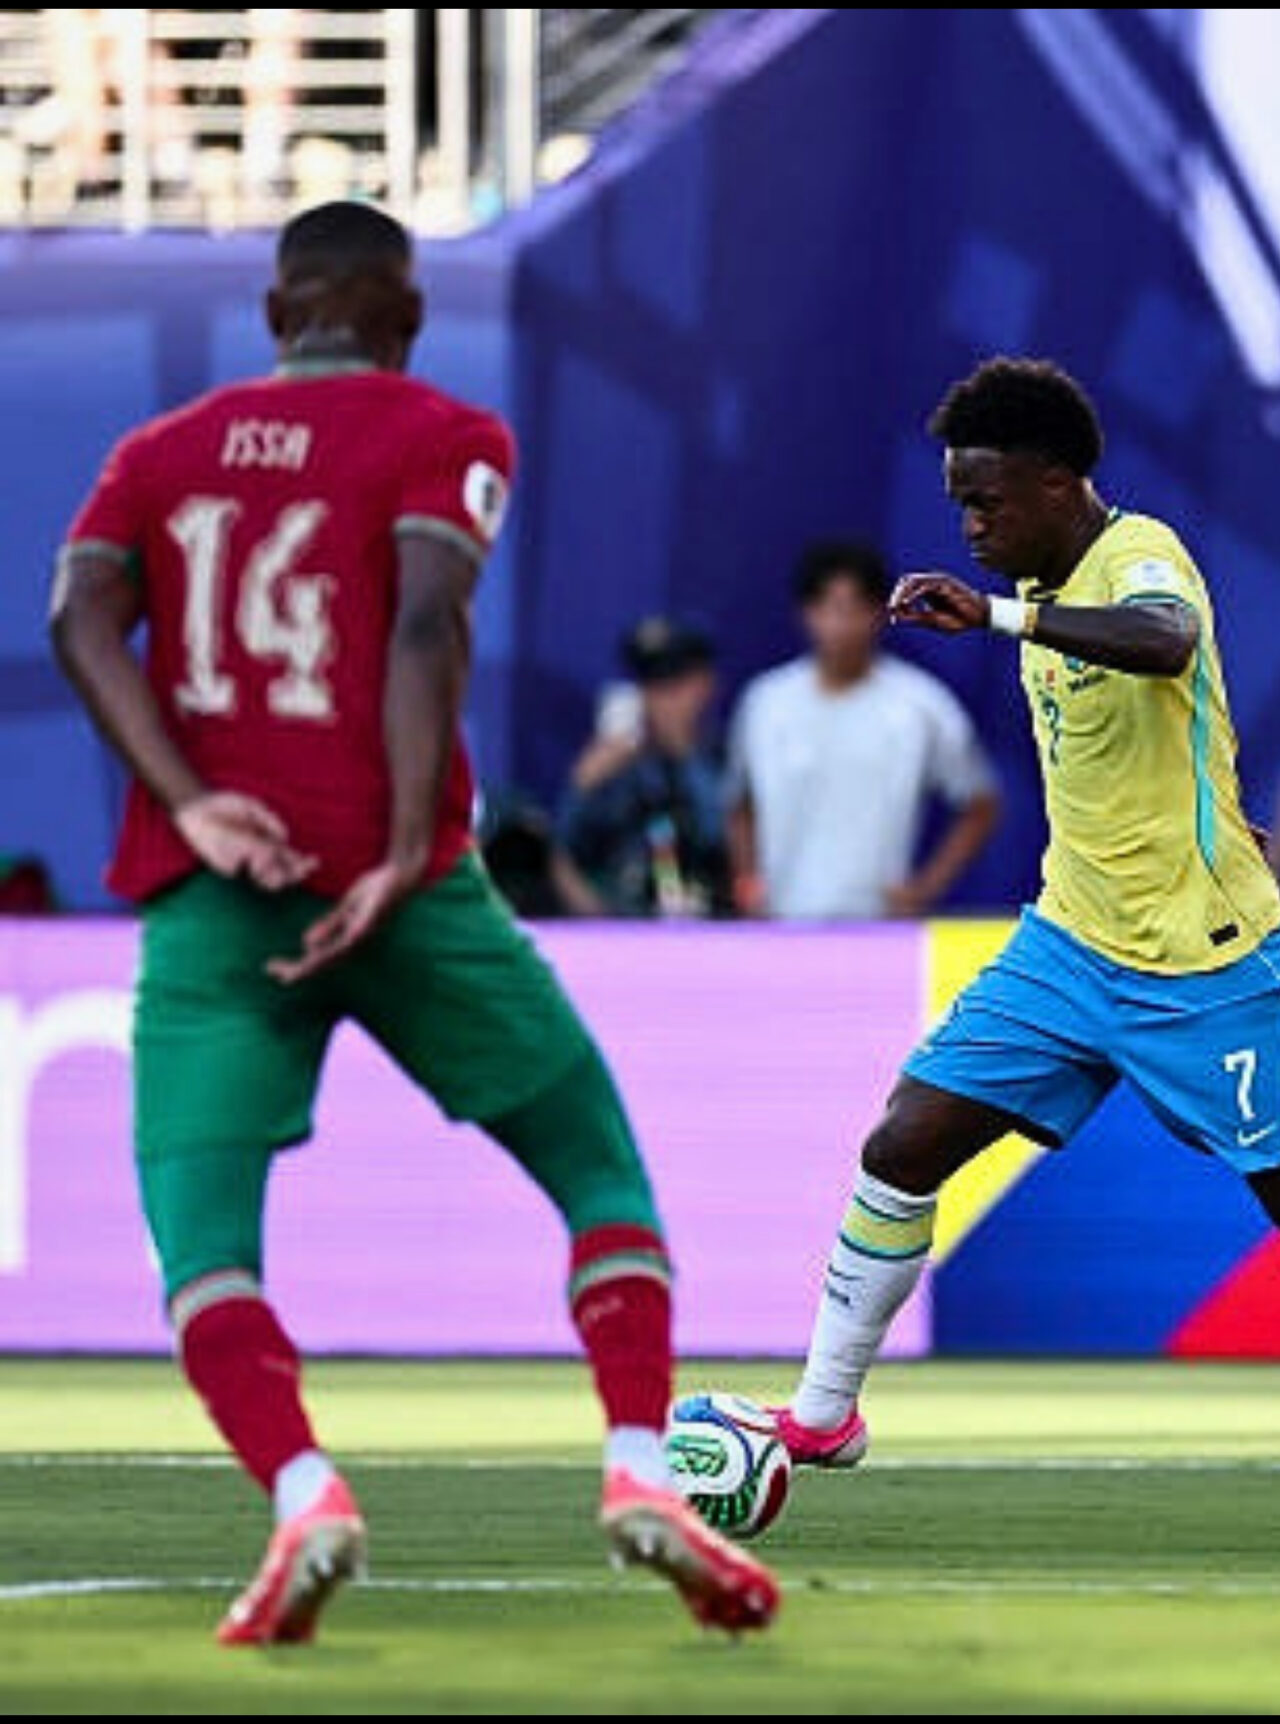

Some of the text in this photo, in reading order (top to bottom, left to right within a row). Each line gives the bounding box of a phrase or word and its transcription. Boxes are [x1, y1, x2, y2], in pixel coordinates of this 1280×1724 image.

[220, 418, 312, 472] ISSA
[168, 494, 337, 718] 14
[1224, 1048, 1257, 1121] 7
